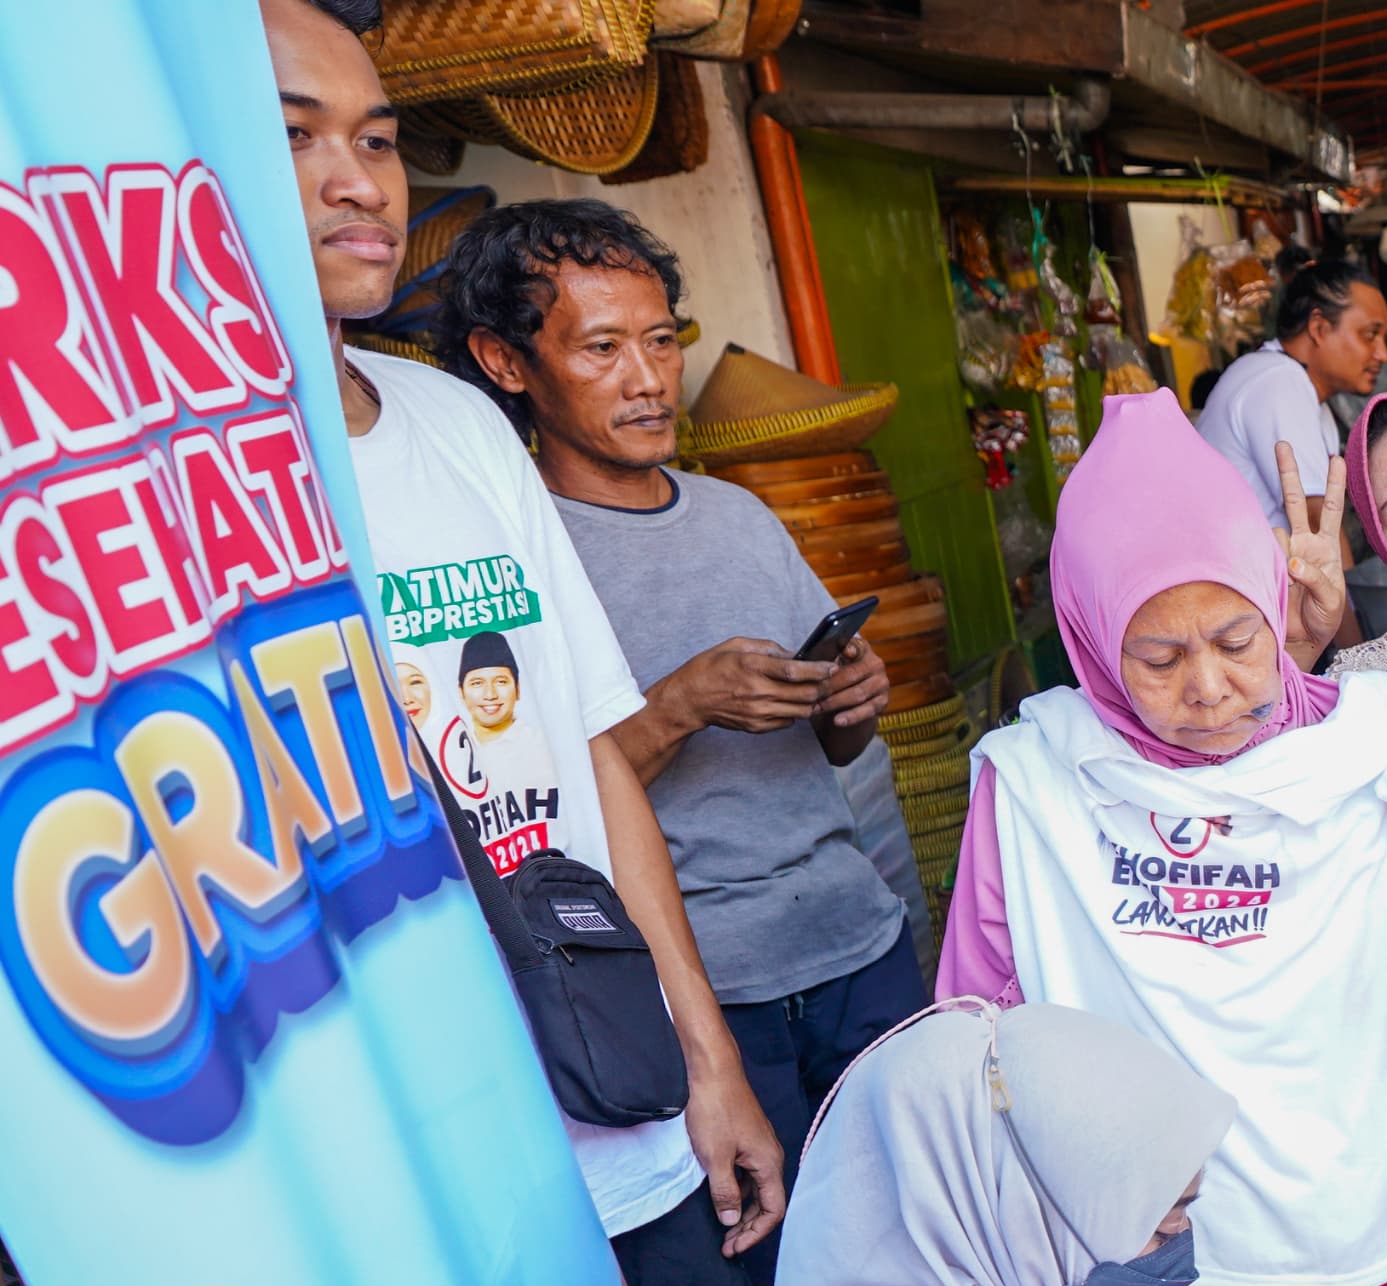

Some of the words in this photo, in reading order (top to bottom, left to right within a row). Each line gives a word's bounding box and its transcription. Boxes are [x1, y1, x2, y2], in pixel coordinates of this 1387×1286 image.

[459, 730, 482, 784] 2
[12, 612, 433, 1042] GRATI
[1182, 891, 1262, 911] 2024
